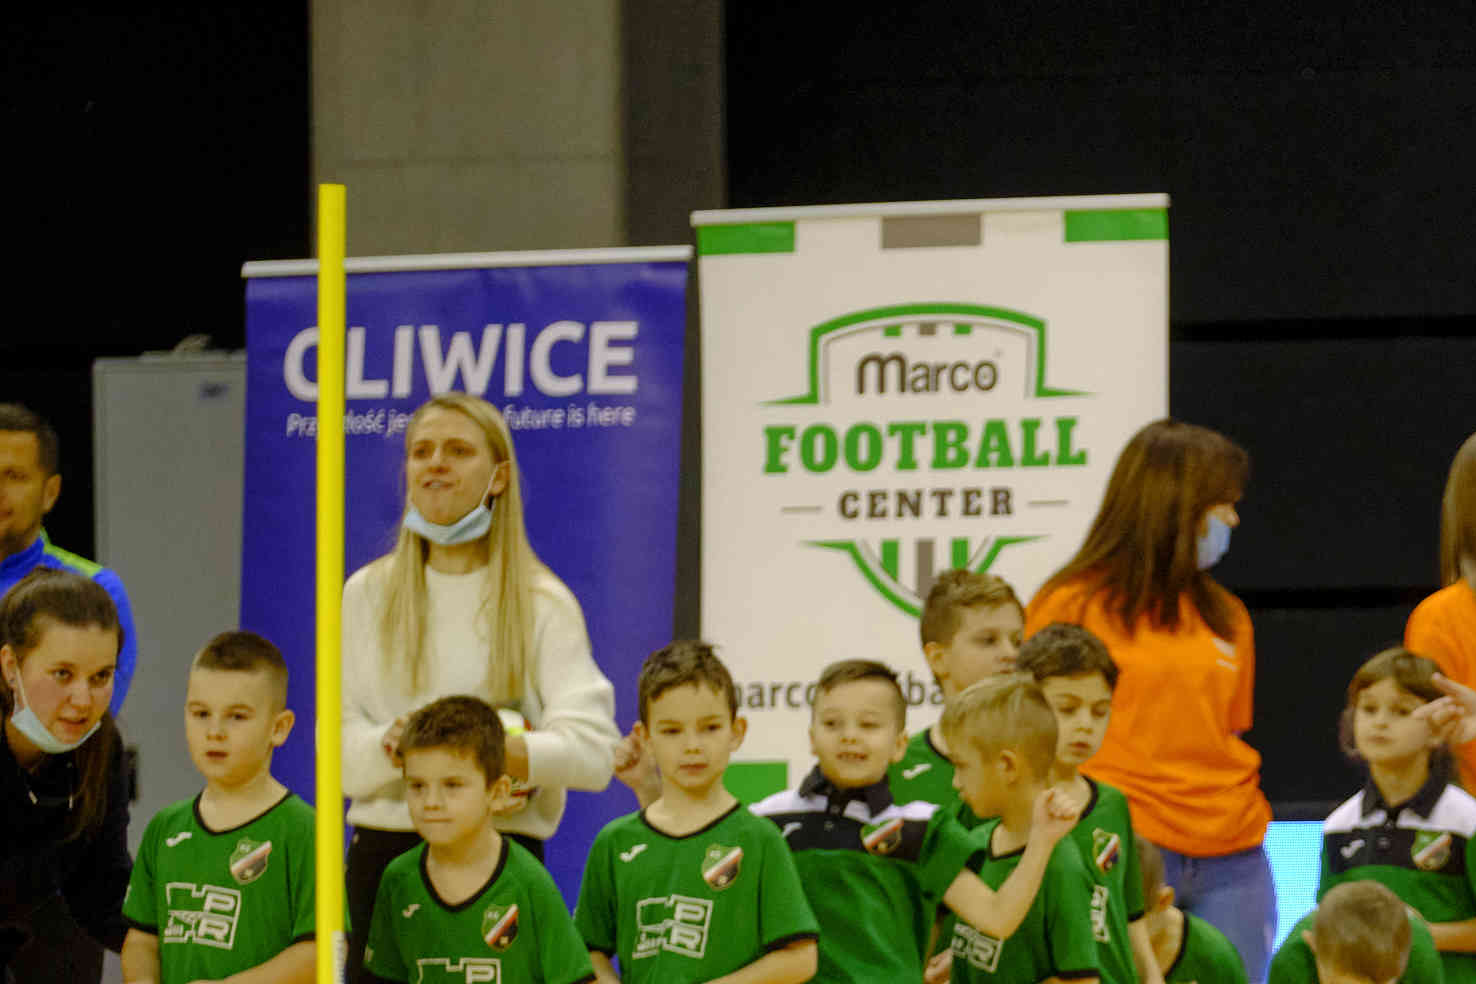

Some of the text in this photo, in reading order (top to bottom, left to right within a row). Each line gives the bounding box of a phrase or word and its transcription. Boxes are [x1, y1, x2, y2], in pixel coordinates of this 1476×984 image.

[857, 352, 998, 395] Marco
[503, 402, 636, 430] future is here
[762, 416, 1087, 474] FOOTBALL
[837, 487, 1014, 520] CENTER
